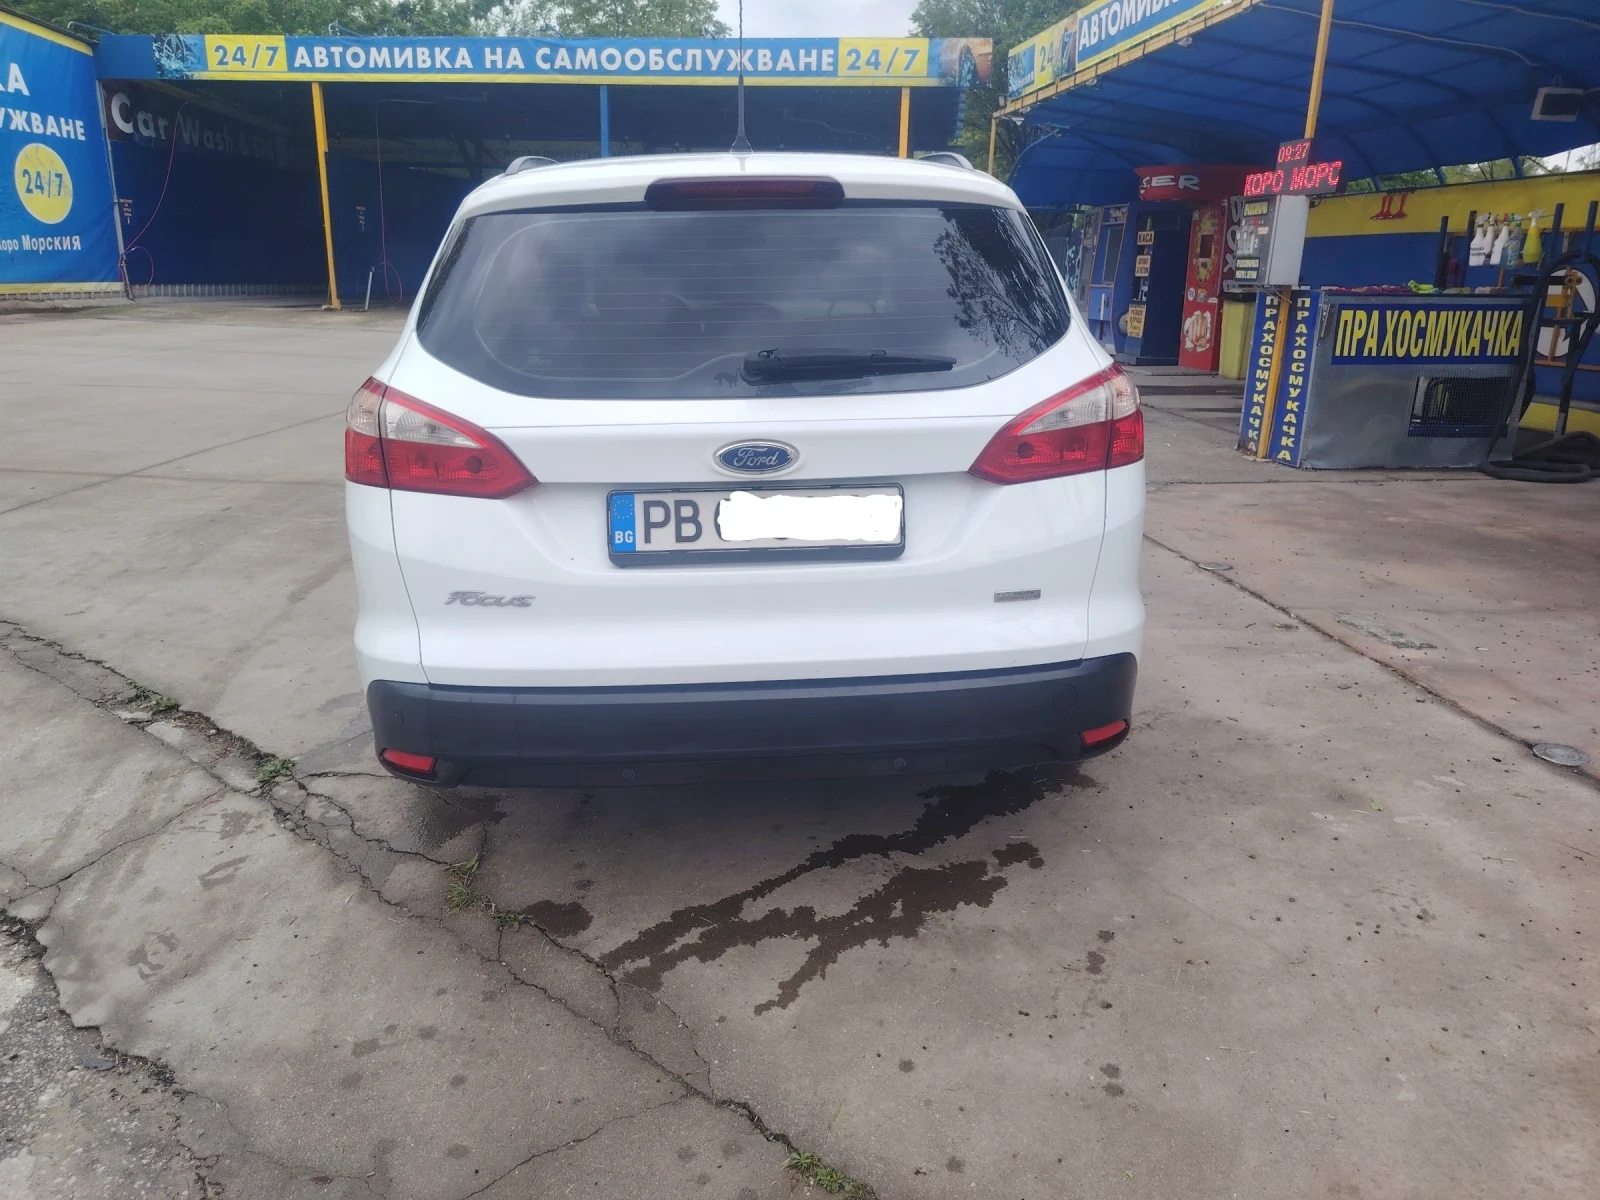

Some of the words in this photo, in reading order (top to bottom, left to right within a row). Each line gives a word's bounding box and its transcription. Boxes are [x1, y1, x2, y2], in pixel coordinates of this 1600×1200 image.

[213, 44, 280, 68] 24/7
[294, 46, 474, 69] АВТОМИВКА
[484, 46, 525, 70] НА
[535, 47, 834, 72] САМООБСЛУЖВАНЕ
[845, 47, 921, 73] 24/7
[0, 62, 31, 96] А
[111, 92, 168, 140] Car
[1277, 141, 1310, 163] 09:27
[22, 168, 64, 198] 24/7
[1290, 160, 1342, 191] МОРС
[21, 234, 82, 254] Морския
[1334, 309, 1524, 358] ПРАХОСМУКАЧКА
[1247, 295, 1278, 452] ПРАХОСМУКАЧКА
[1276, 297, 1311, 461] ПРАХОСМУКАЧКА
[733, 447, 780, 467] Ford
[614, 530, 634, 544] BG
[643, 499, 703, 544] PB
